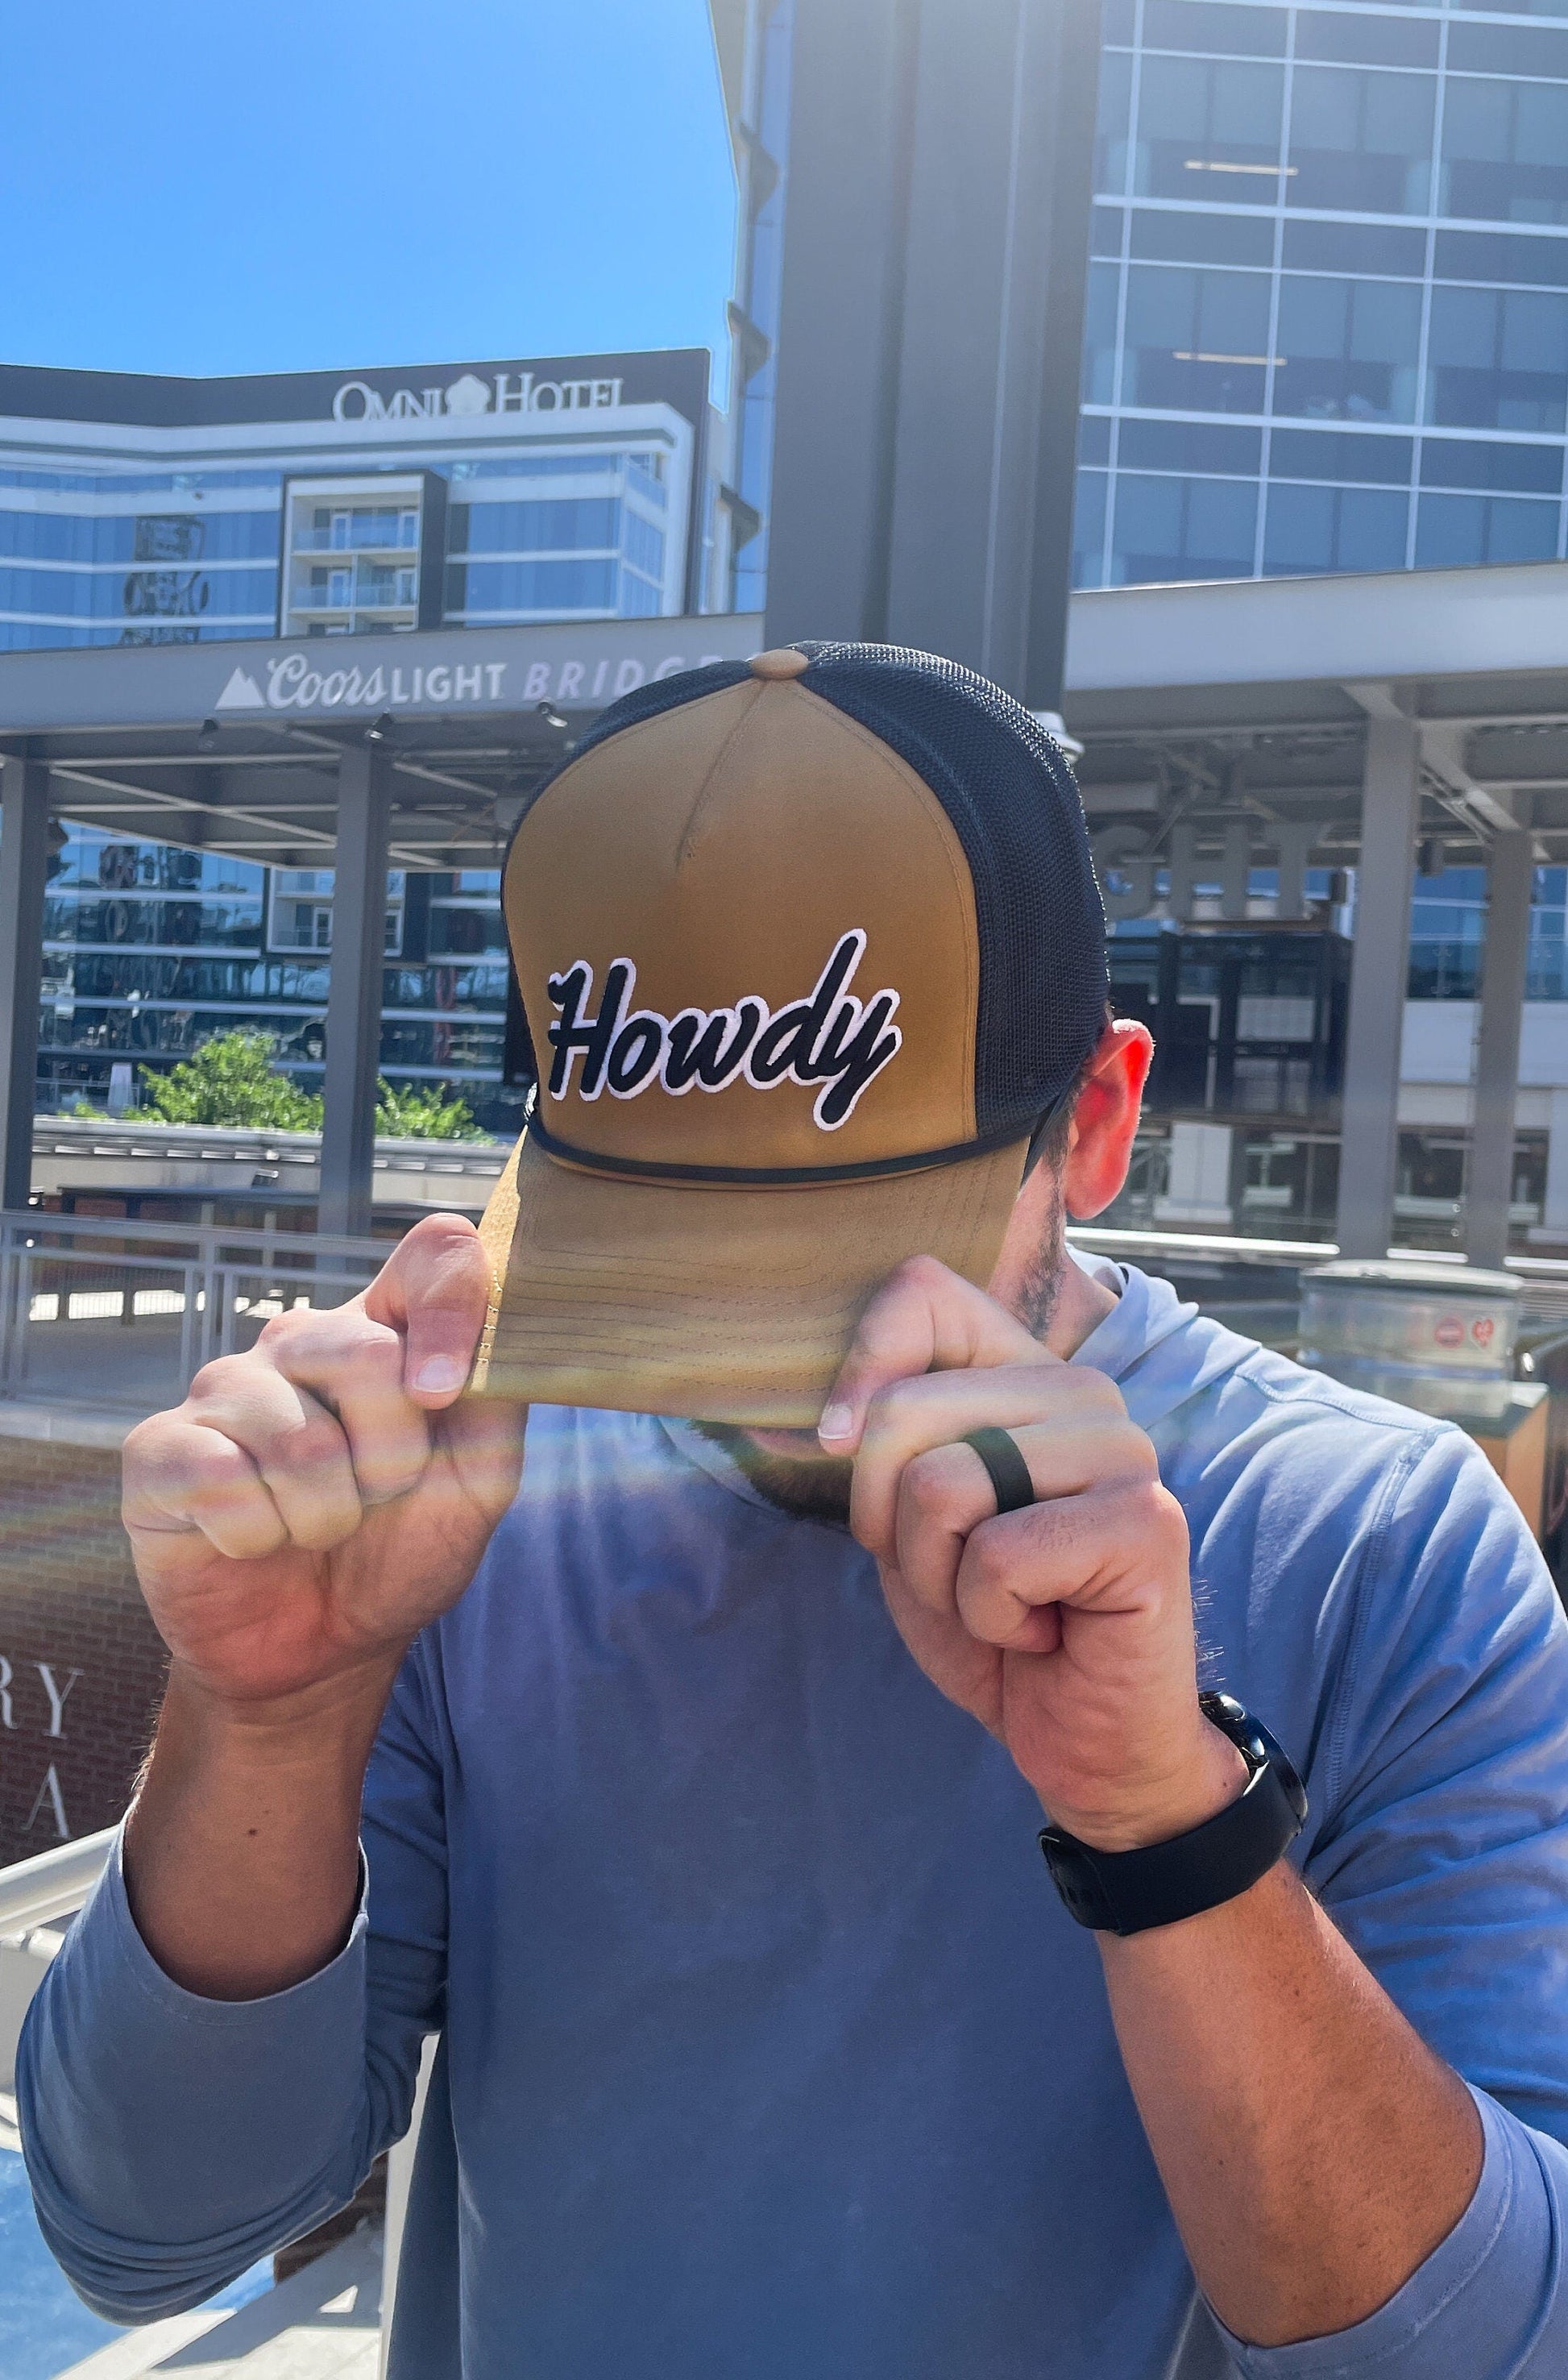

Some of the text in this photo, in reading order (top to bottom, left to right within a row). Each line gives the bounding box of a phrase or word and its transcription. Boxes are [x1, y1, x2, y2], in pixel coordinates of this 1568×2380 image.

[332, 380, 443, 422] OMNI
[267, 652, 721, 709] Coors LIGHT BRID
[547, 928, 903, 1132] Howdy
